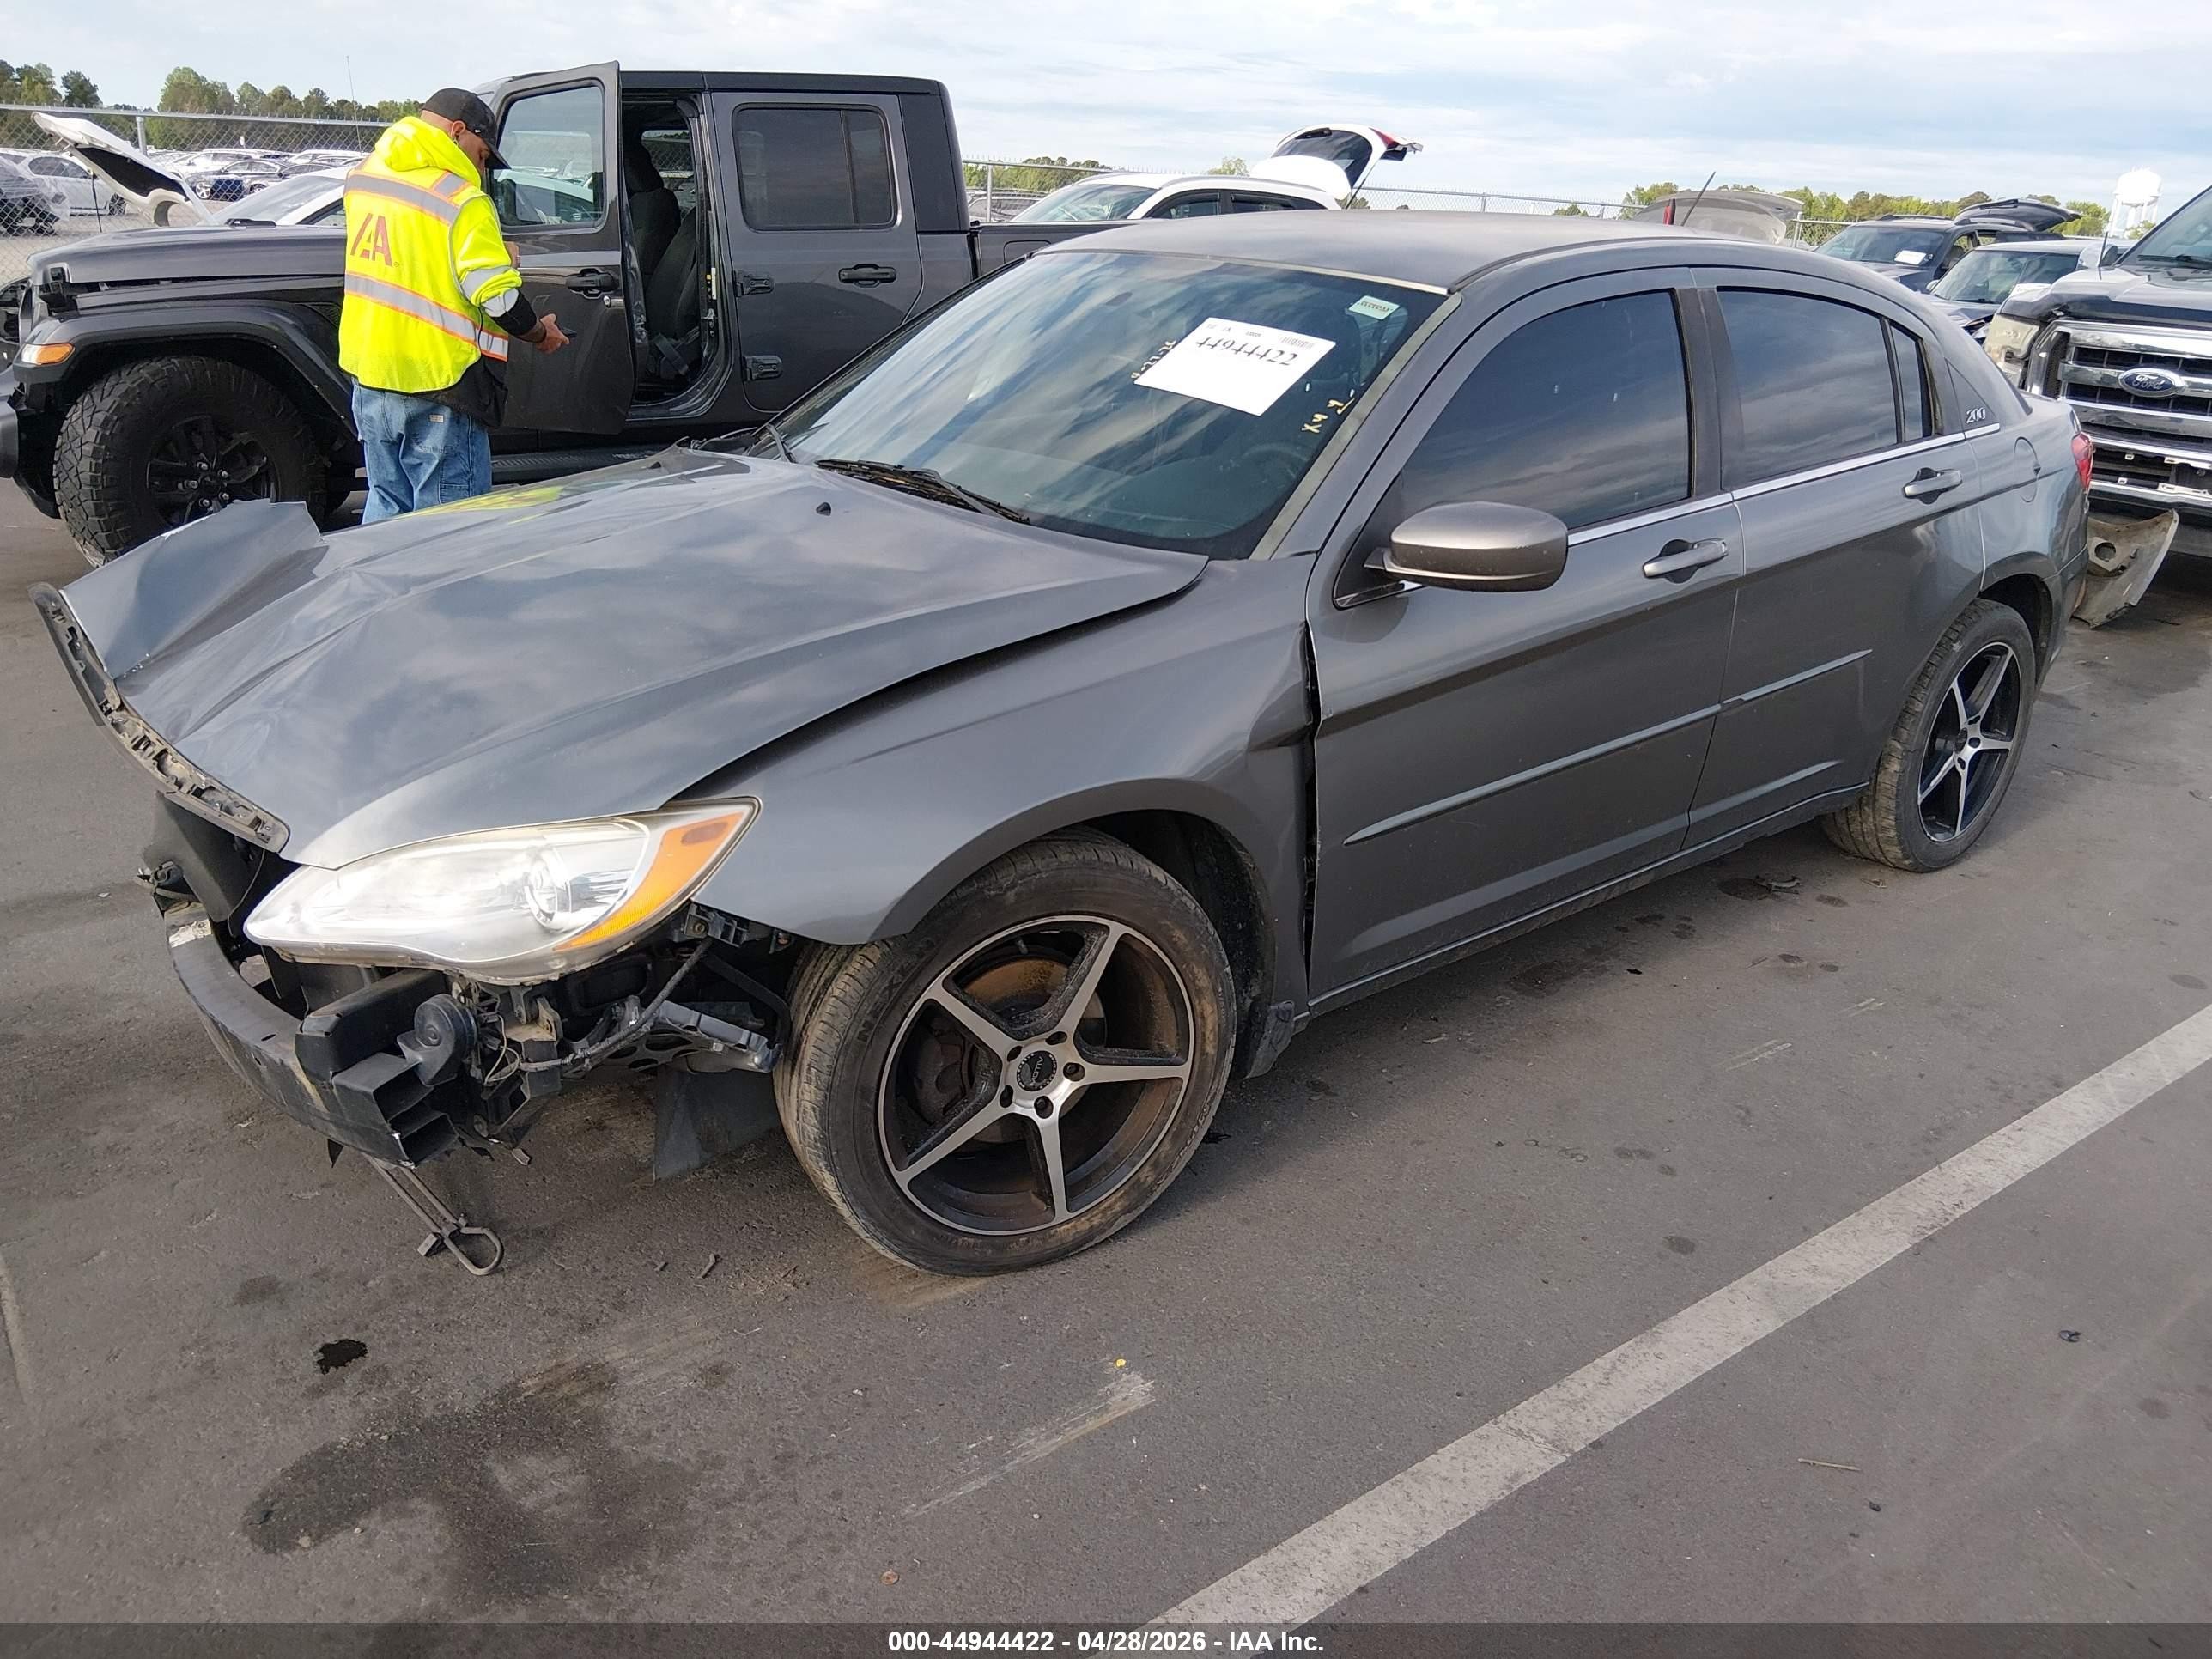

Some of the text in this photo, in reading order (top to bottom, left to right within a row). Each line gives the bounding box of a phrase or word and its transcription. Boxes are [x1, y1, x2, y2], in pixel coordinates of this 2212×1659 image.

[1195, 336, 1298, 366] 44944422
[2132, 374, 2165, 390] Ford
[1966, 407, 1986, 423] 200
[1029, 1056, 1044, 1086] MOTIV
